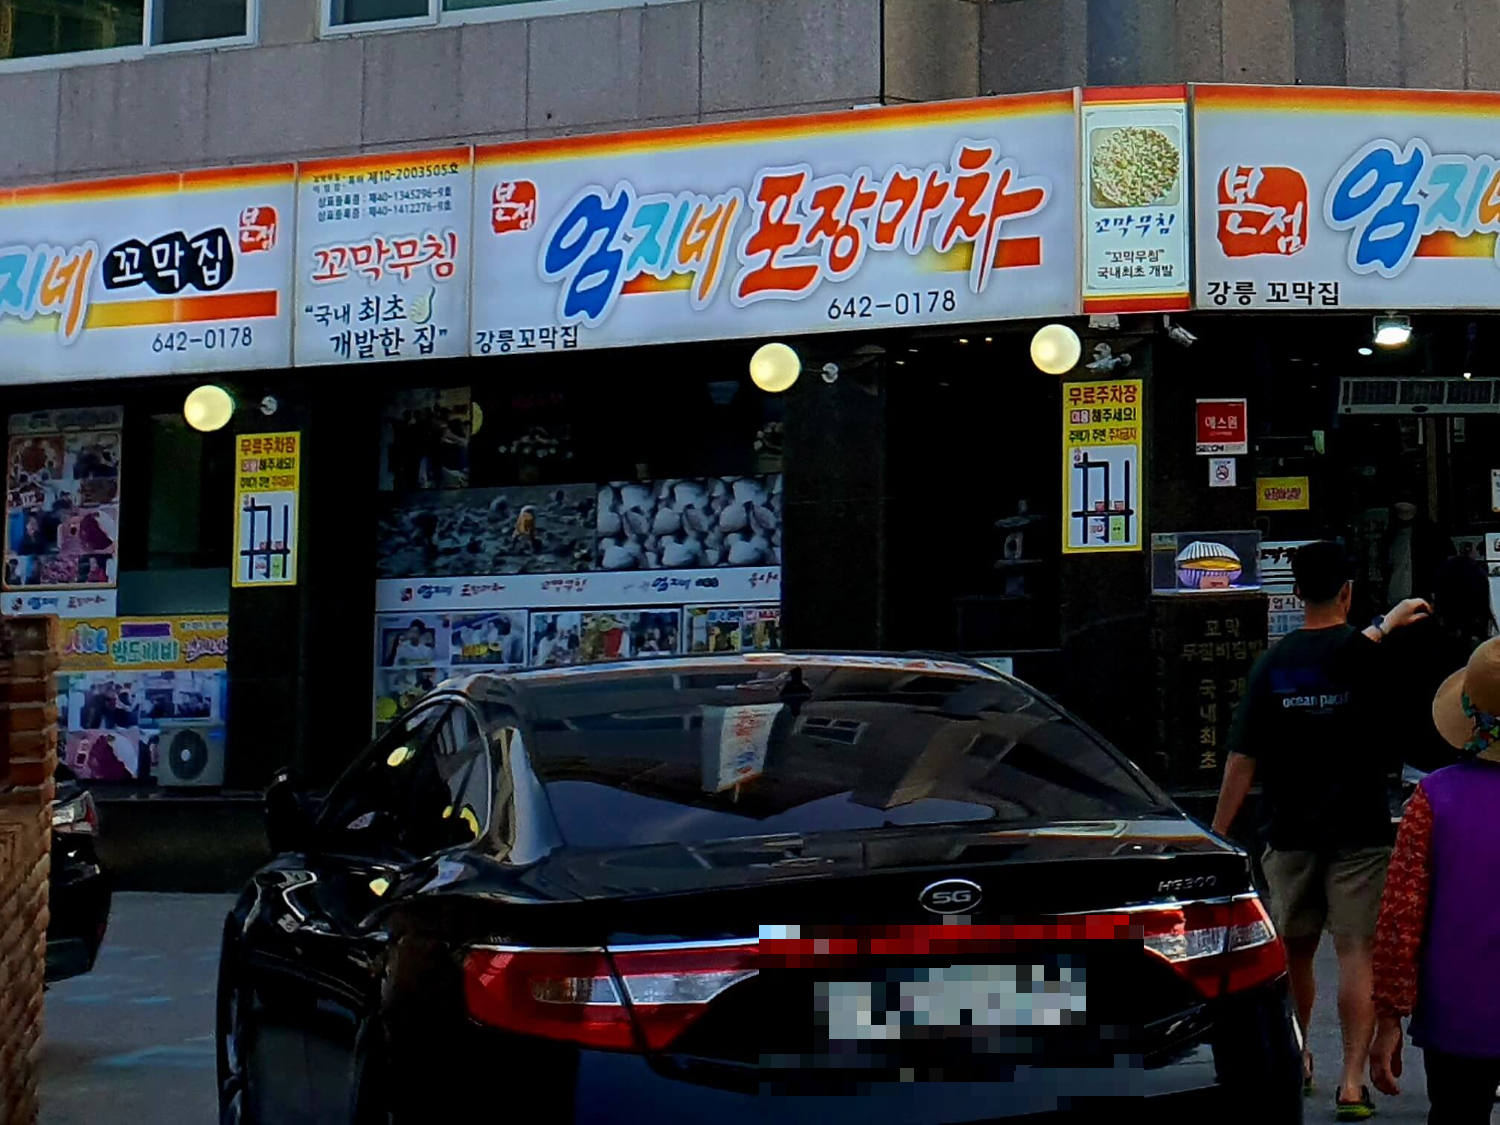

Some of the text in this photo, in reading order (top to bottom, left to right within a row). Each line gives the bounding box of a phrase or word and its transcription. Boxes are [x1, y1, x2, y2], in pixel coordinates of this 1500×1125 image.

[491, 180, 538, 234] 본점
[1215, 165, 1309, 258] 본점
[239, 206, 277, 252] 본점
[544, 146, 1045, 320] 엄지네 포장마차
[1094, 212, 1176, 238] 꼬막무침
[112, 235, 224, 288] 꼬막집
[311, 231, 458, 282] 꼬막무침
[1097, 264, 1174, 280] 국내최초 개발
[826, 289, 956, 320] 642-0178
[1206, 279, 1341, 306] 강릉 꼬막집
[357, 293, 408, 325] 최초
[151, 327, 253, 353] 642-0178
[1069, 385, 1138, 406] 무료주차장
[931, 889, 972, 904] SG
